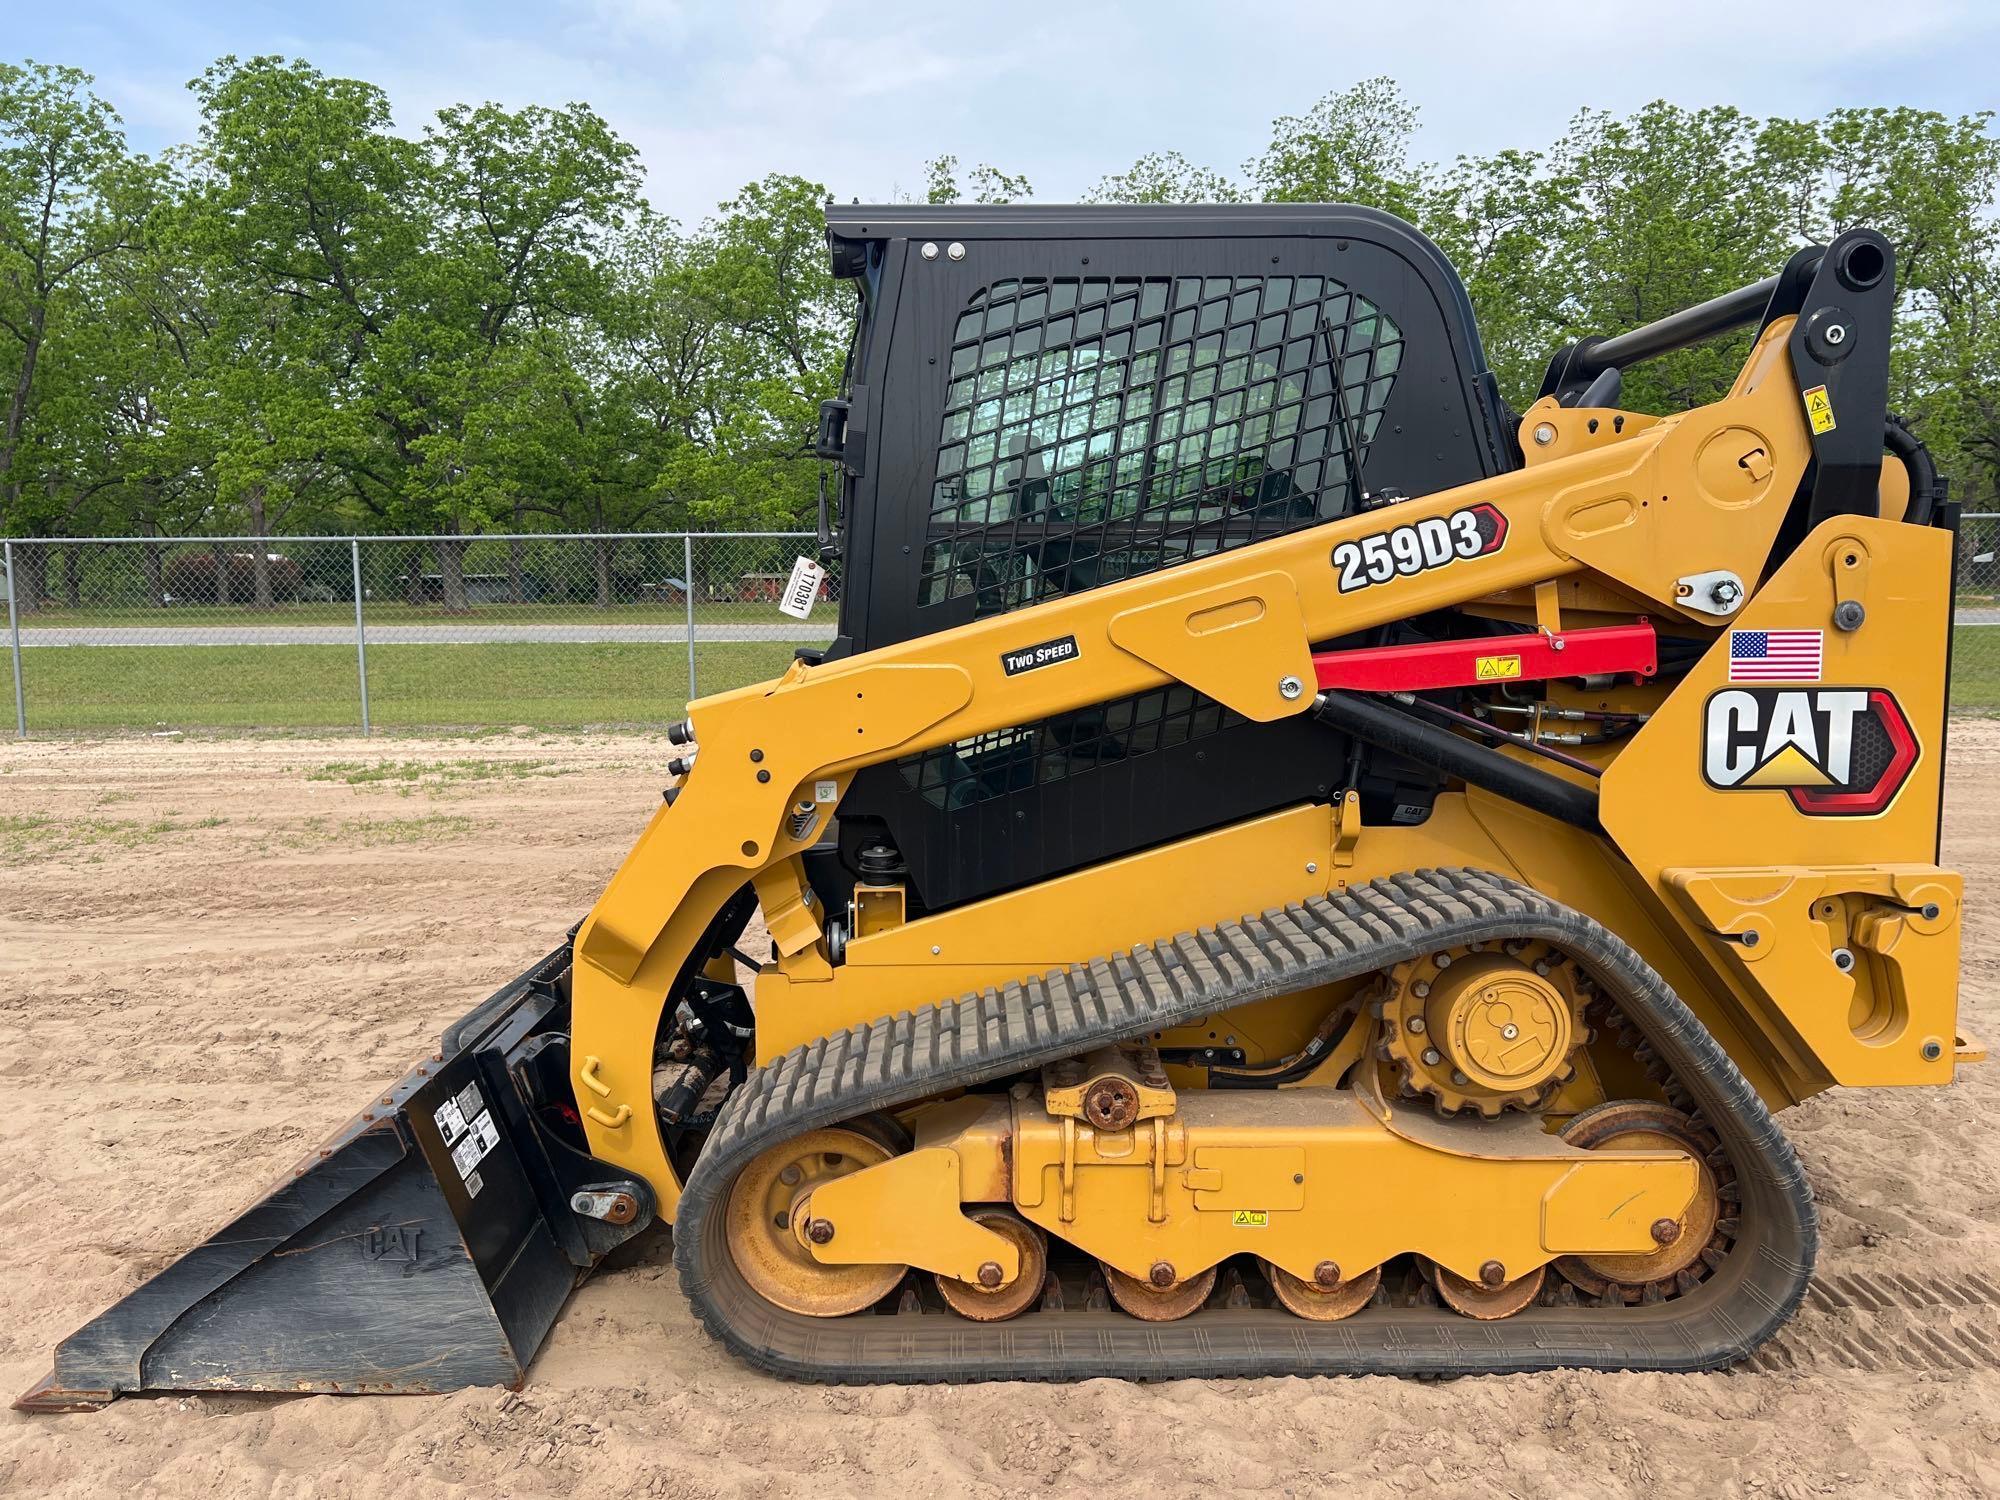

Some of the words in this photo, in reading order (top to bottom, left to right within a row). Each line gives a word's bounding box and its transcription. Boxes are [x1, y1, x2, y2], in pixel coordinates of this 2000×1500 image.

[1333, 510, 1483, 591] 259D3
[792, 573, 817, 611] 170381
[1706, 690, 1869, 785] CAT
[1404, 806, 1424, 816] CAT
[363, 1226, 422, 1261] CAT
